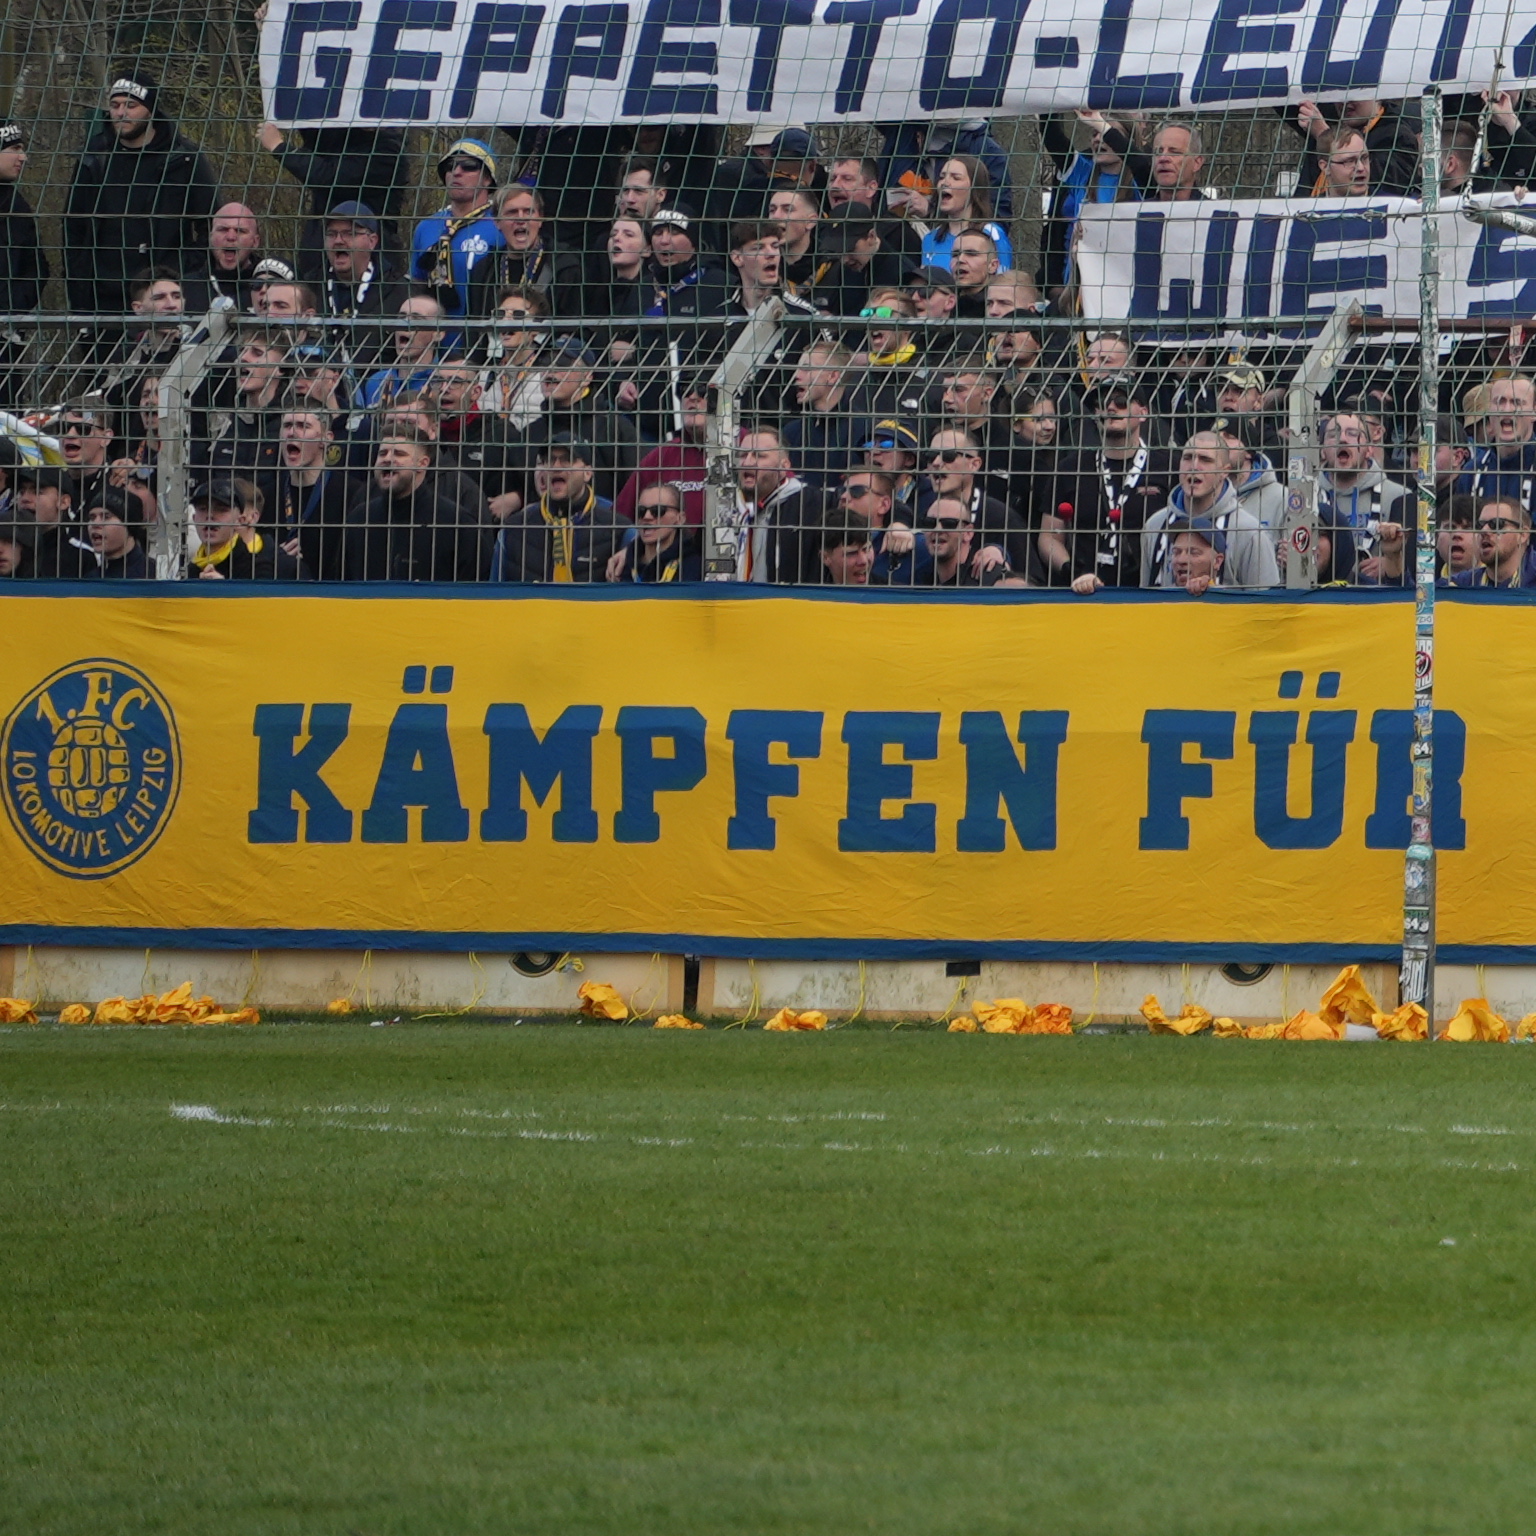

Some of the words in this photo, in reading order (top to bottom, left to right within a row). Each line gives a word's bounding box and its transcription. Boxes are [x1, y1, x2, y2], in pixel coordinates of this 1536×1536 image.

[1130, 208, 1389, 340] WIE
[115, 746, 168, 847] LEIPZIG
[247, 664, 1070, 853] KÄMPFEN
[1138, 670, 1467, 851] FÜR
